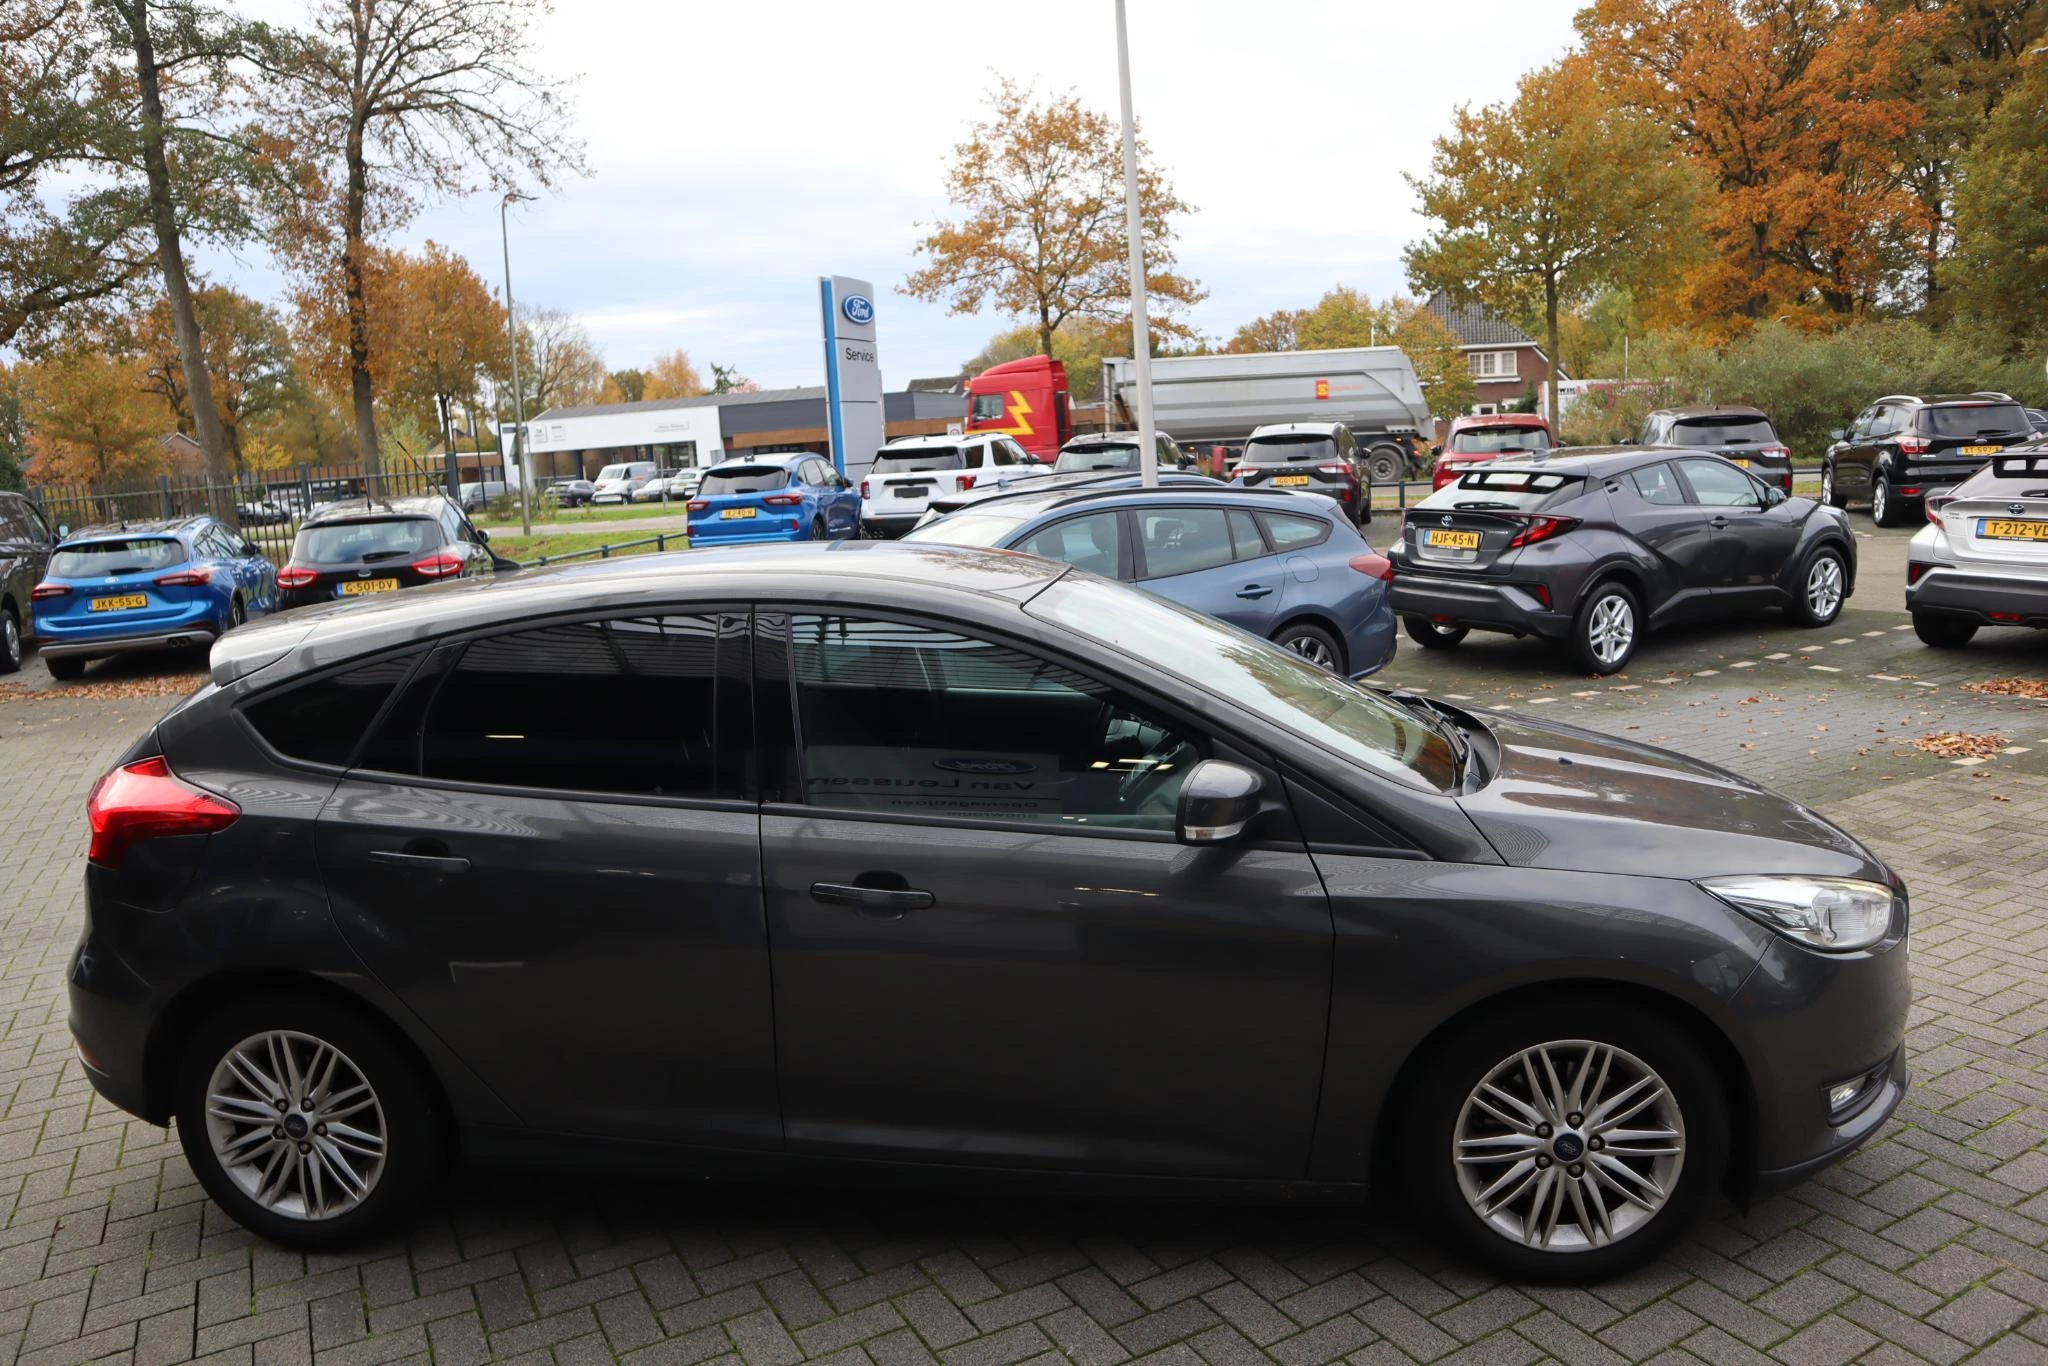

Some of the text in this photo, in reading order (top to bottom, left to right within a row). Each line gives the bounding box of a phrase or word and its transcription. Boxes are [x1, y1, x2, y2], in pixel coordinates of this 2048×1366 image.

[845, 347, 874, 363] Service
[1431, 532, 1475, 546] HJF-45-N
[345, 580, 393, 593] G-501-DV
[95, 596, 143, 609] JKK-55-G
